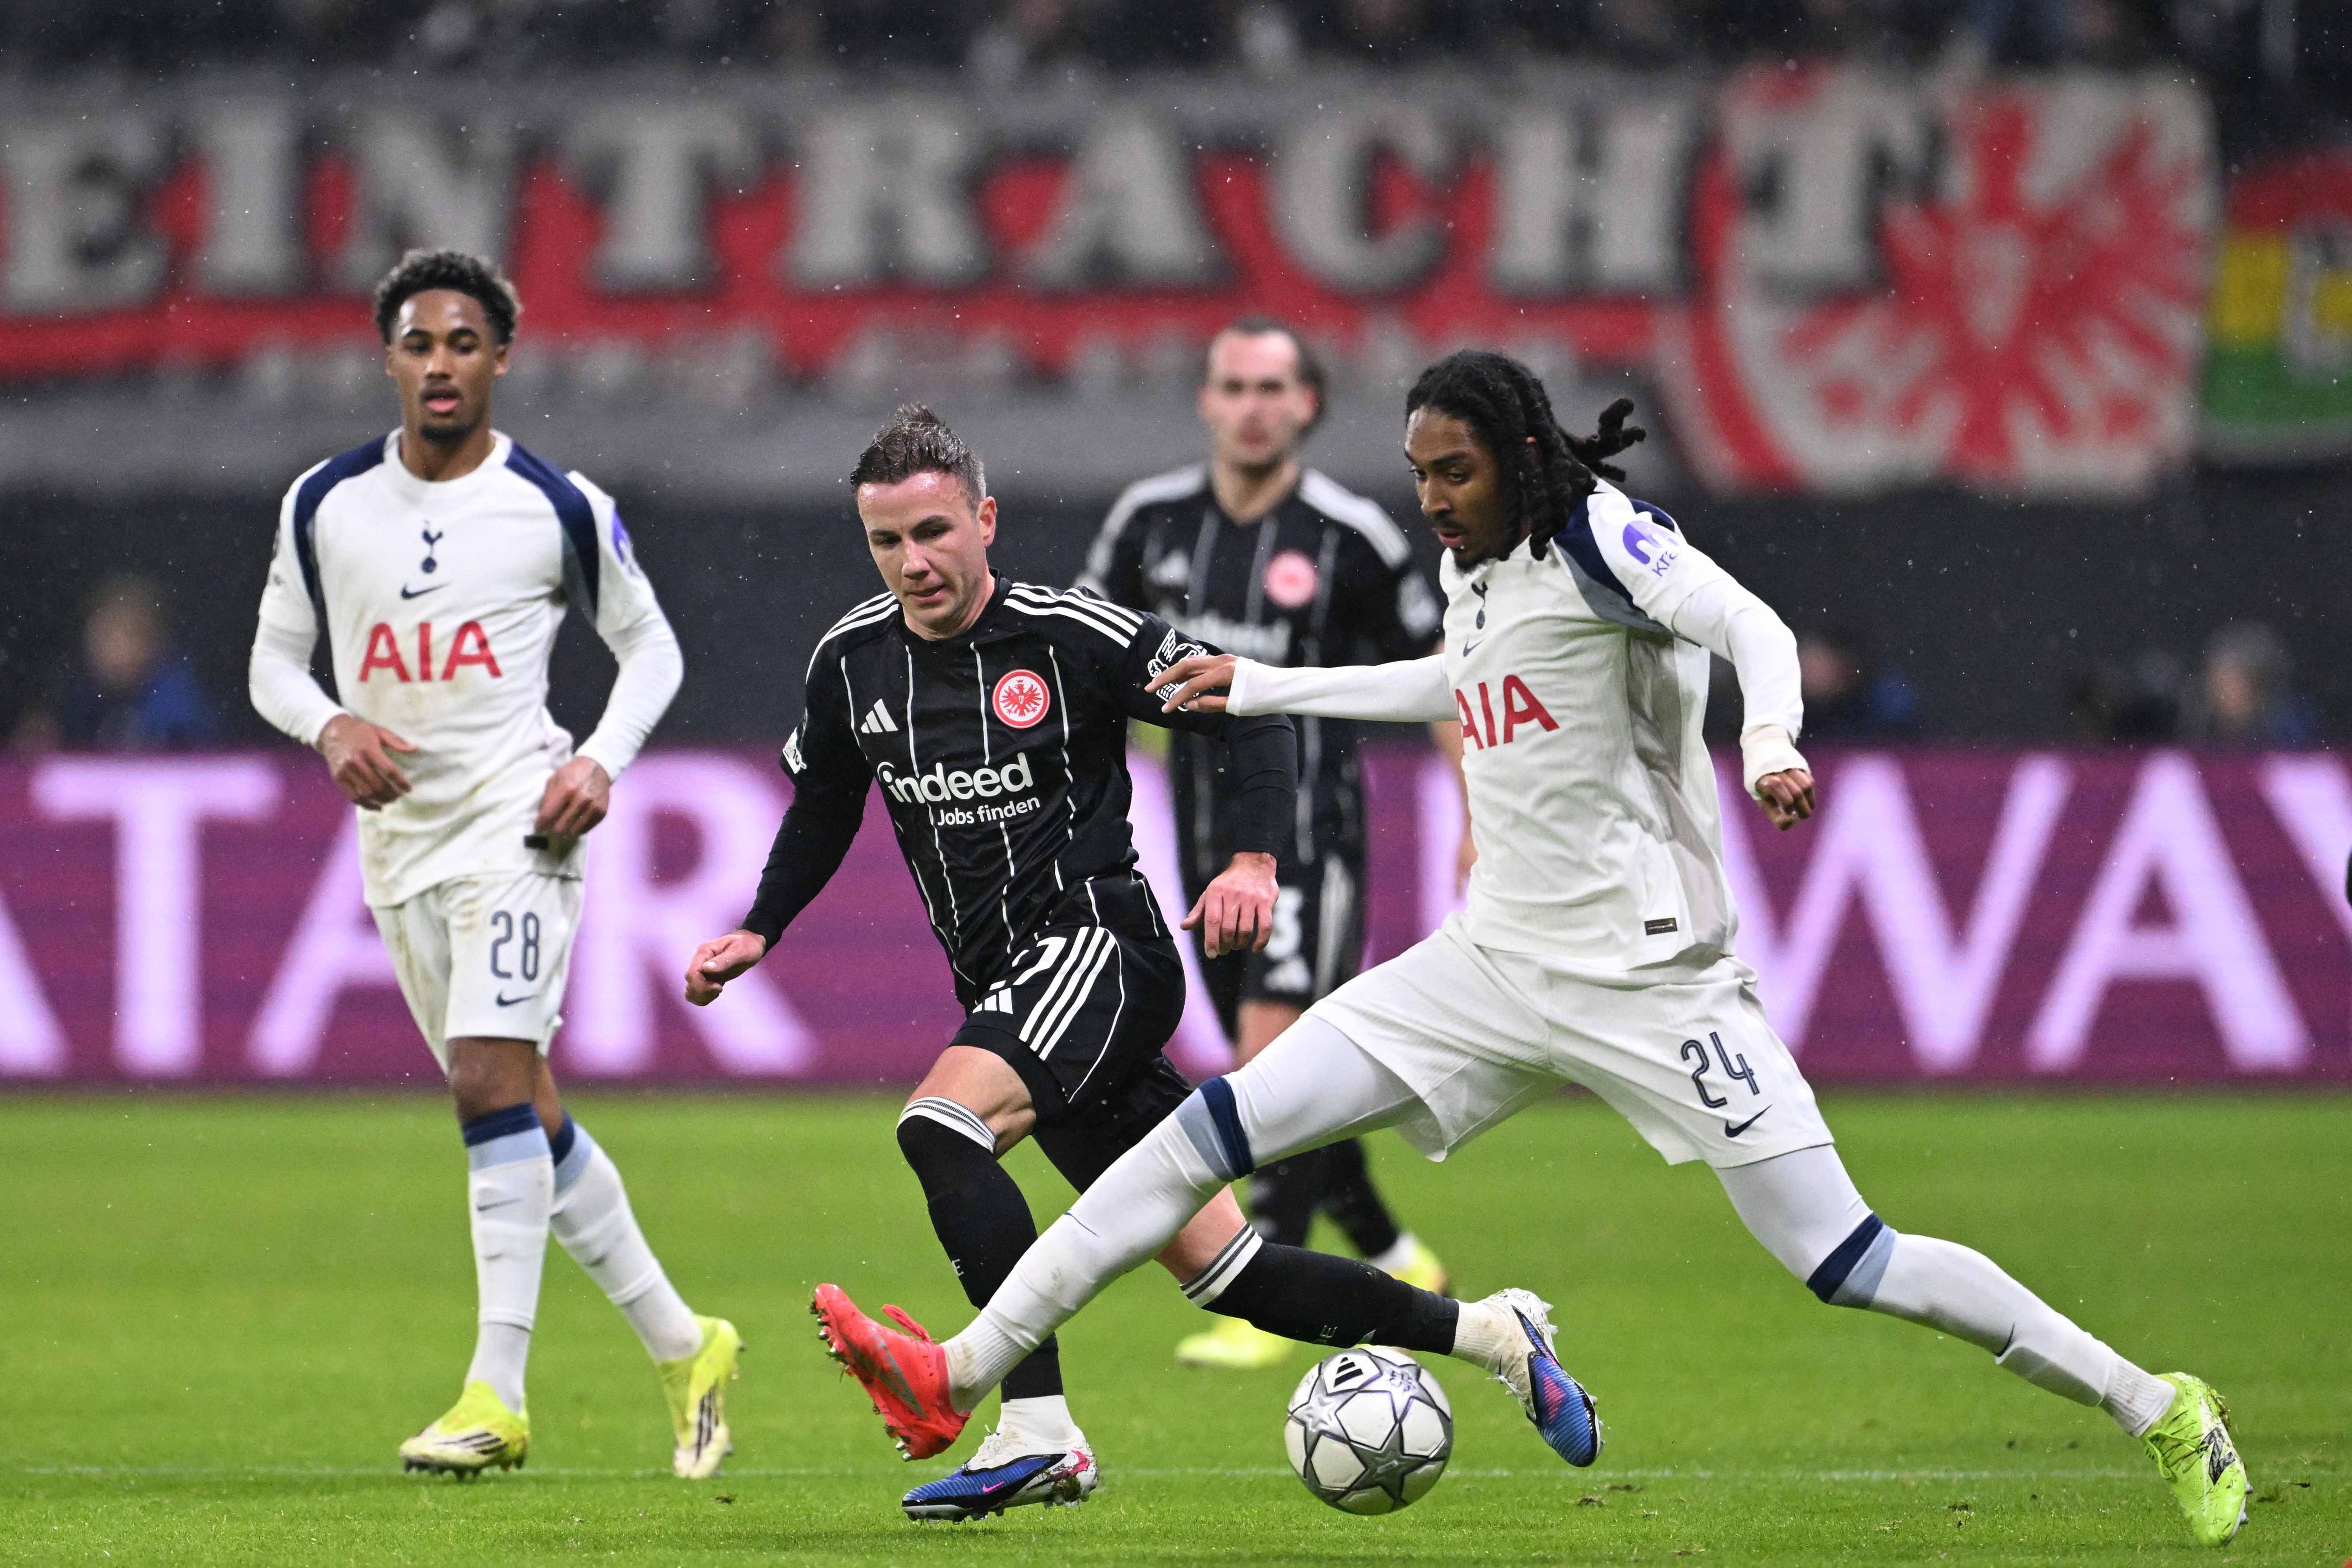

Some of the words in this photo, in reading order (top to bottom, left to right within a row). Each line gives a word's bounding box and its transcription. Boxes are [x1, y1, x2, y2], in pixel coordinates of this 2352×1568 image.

[2, 82, 1943, 311] EINTRACHT
[359, 620, 502, 683] AIA
[1456, 674, 1560, 750] AIA
[877, 752, 1034, 804] indeed
[937, 808, 974, 826] Jobs
[977, 797, 1041, 822] finden
[491, 910, 540, 982] 28
[1680, 1031, 1760, 1108] 24
